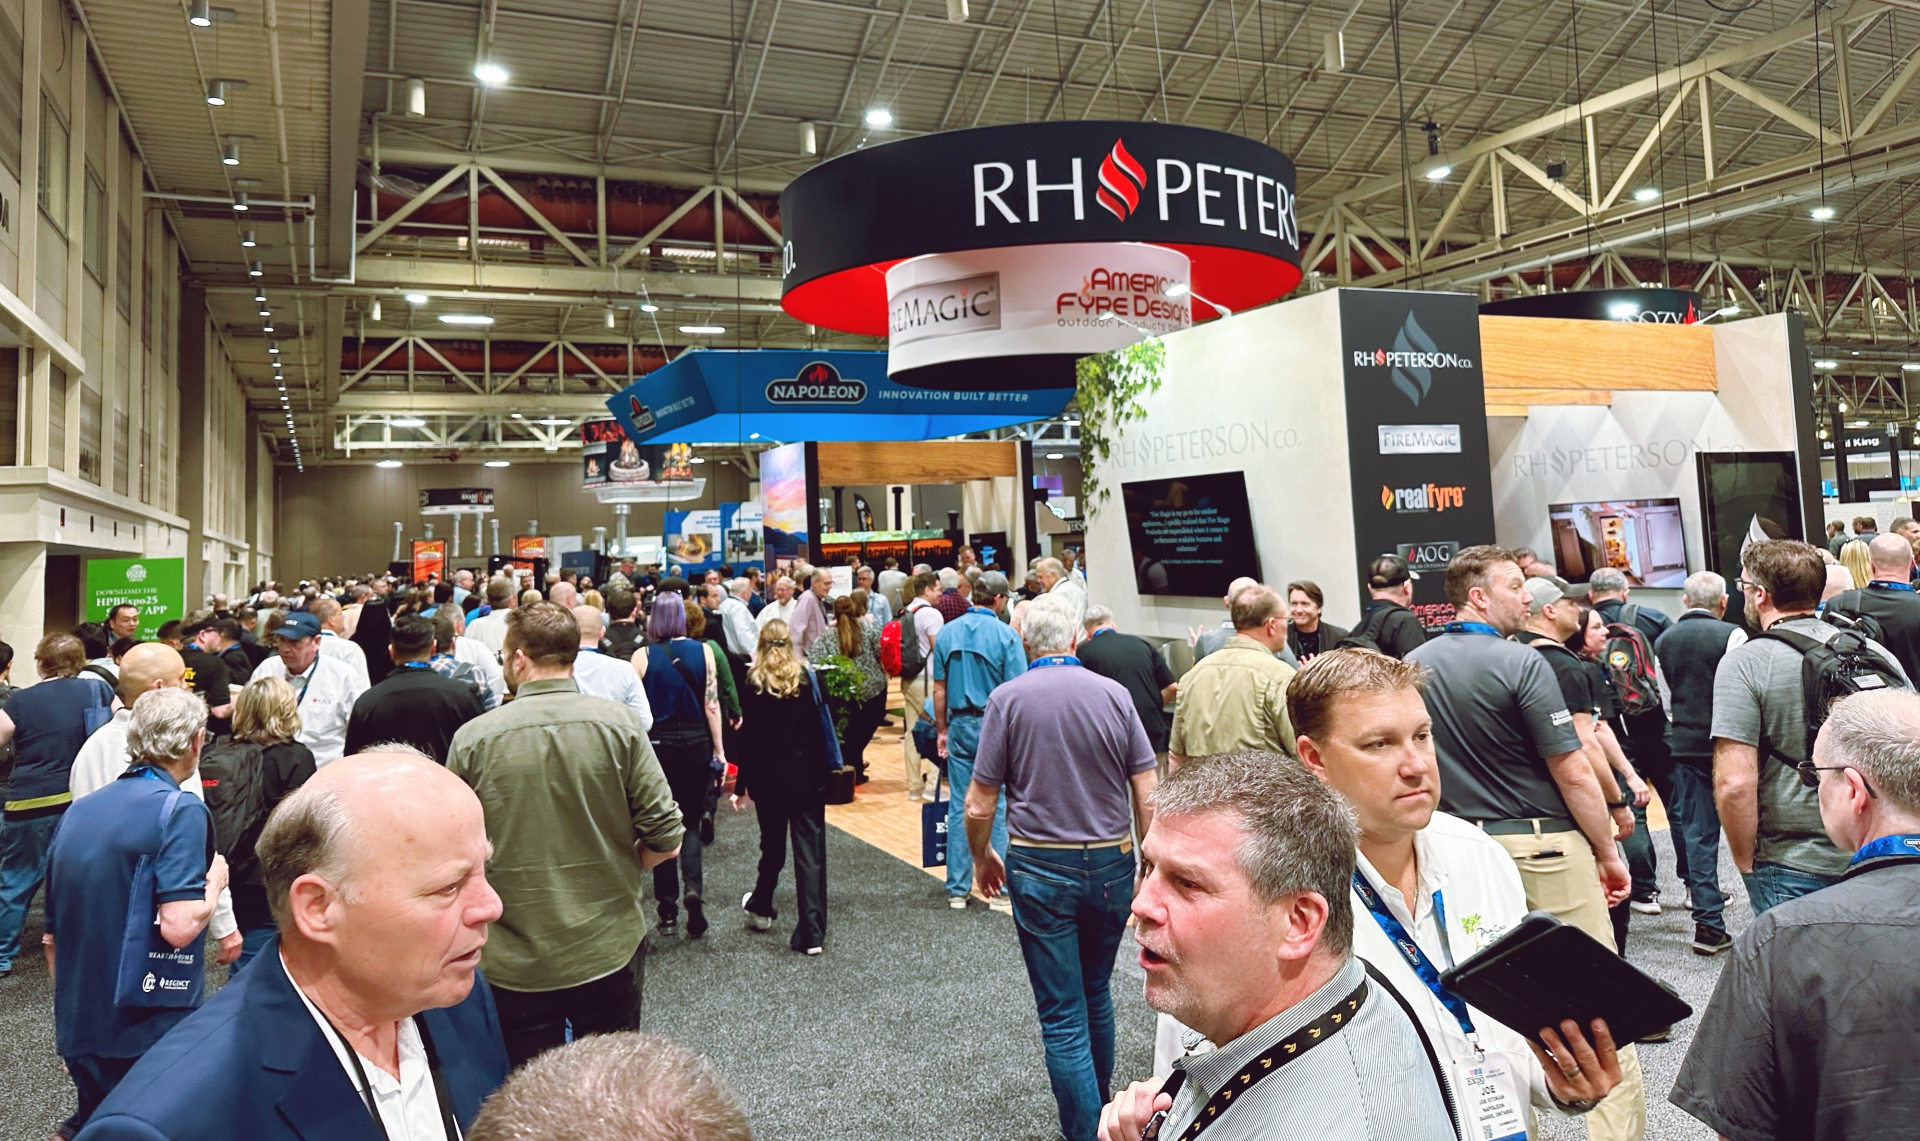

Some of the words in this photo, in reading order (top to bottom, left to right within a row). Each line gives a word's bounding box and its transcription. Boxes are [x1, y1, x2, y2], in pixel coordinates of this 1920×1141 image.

[973, 157, 1085, 226] RH
[1056, 292, 1129, 317] FYRE
[1353, 350, 1376, 367] RH
[1386, 351, 1458, 368] PETERSON
[773, 384, 861, 400] NAPOLEON
[878, 390, 950, 401] INNOVATION
[953, 391, 984, 402] BUILT
[988, 392, 1029, 403] BETTER
[1153, 419, 1269, 464] PETERSON
[1853, 437, 1880, 448] King
[1513, 453, 1547, 478] RH
[1395, 483, 1464, 512] realfyre
[1415, 545, 1450, 564] AOG
[96, 588, 141, 596] DOWNLOAD
[143, 587, 158, 595] THE
[145, 605, 168, 616] APP
[1481, 1084, 1497, 1096] JOE
